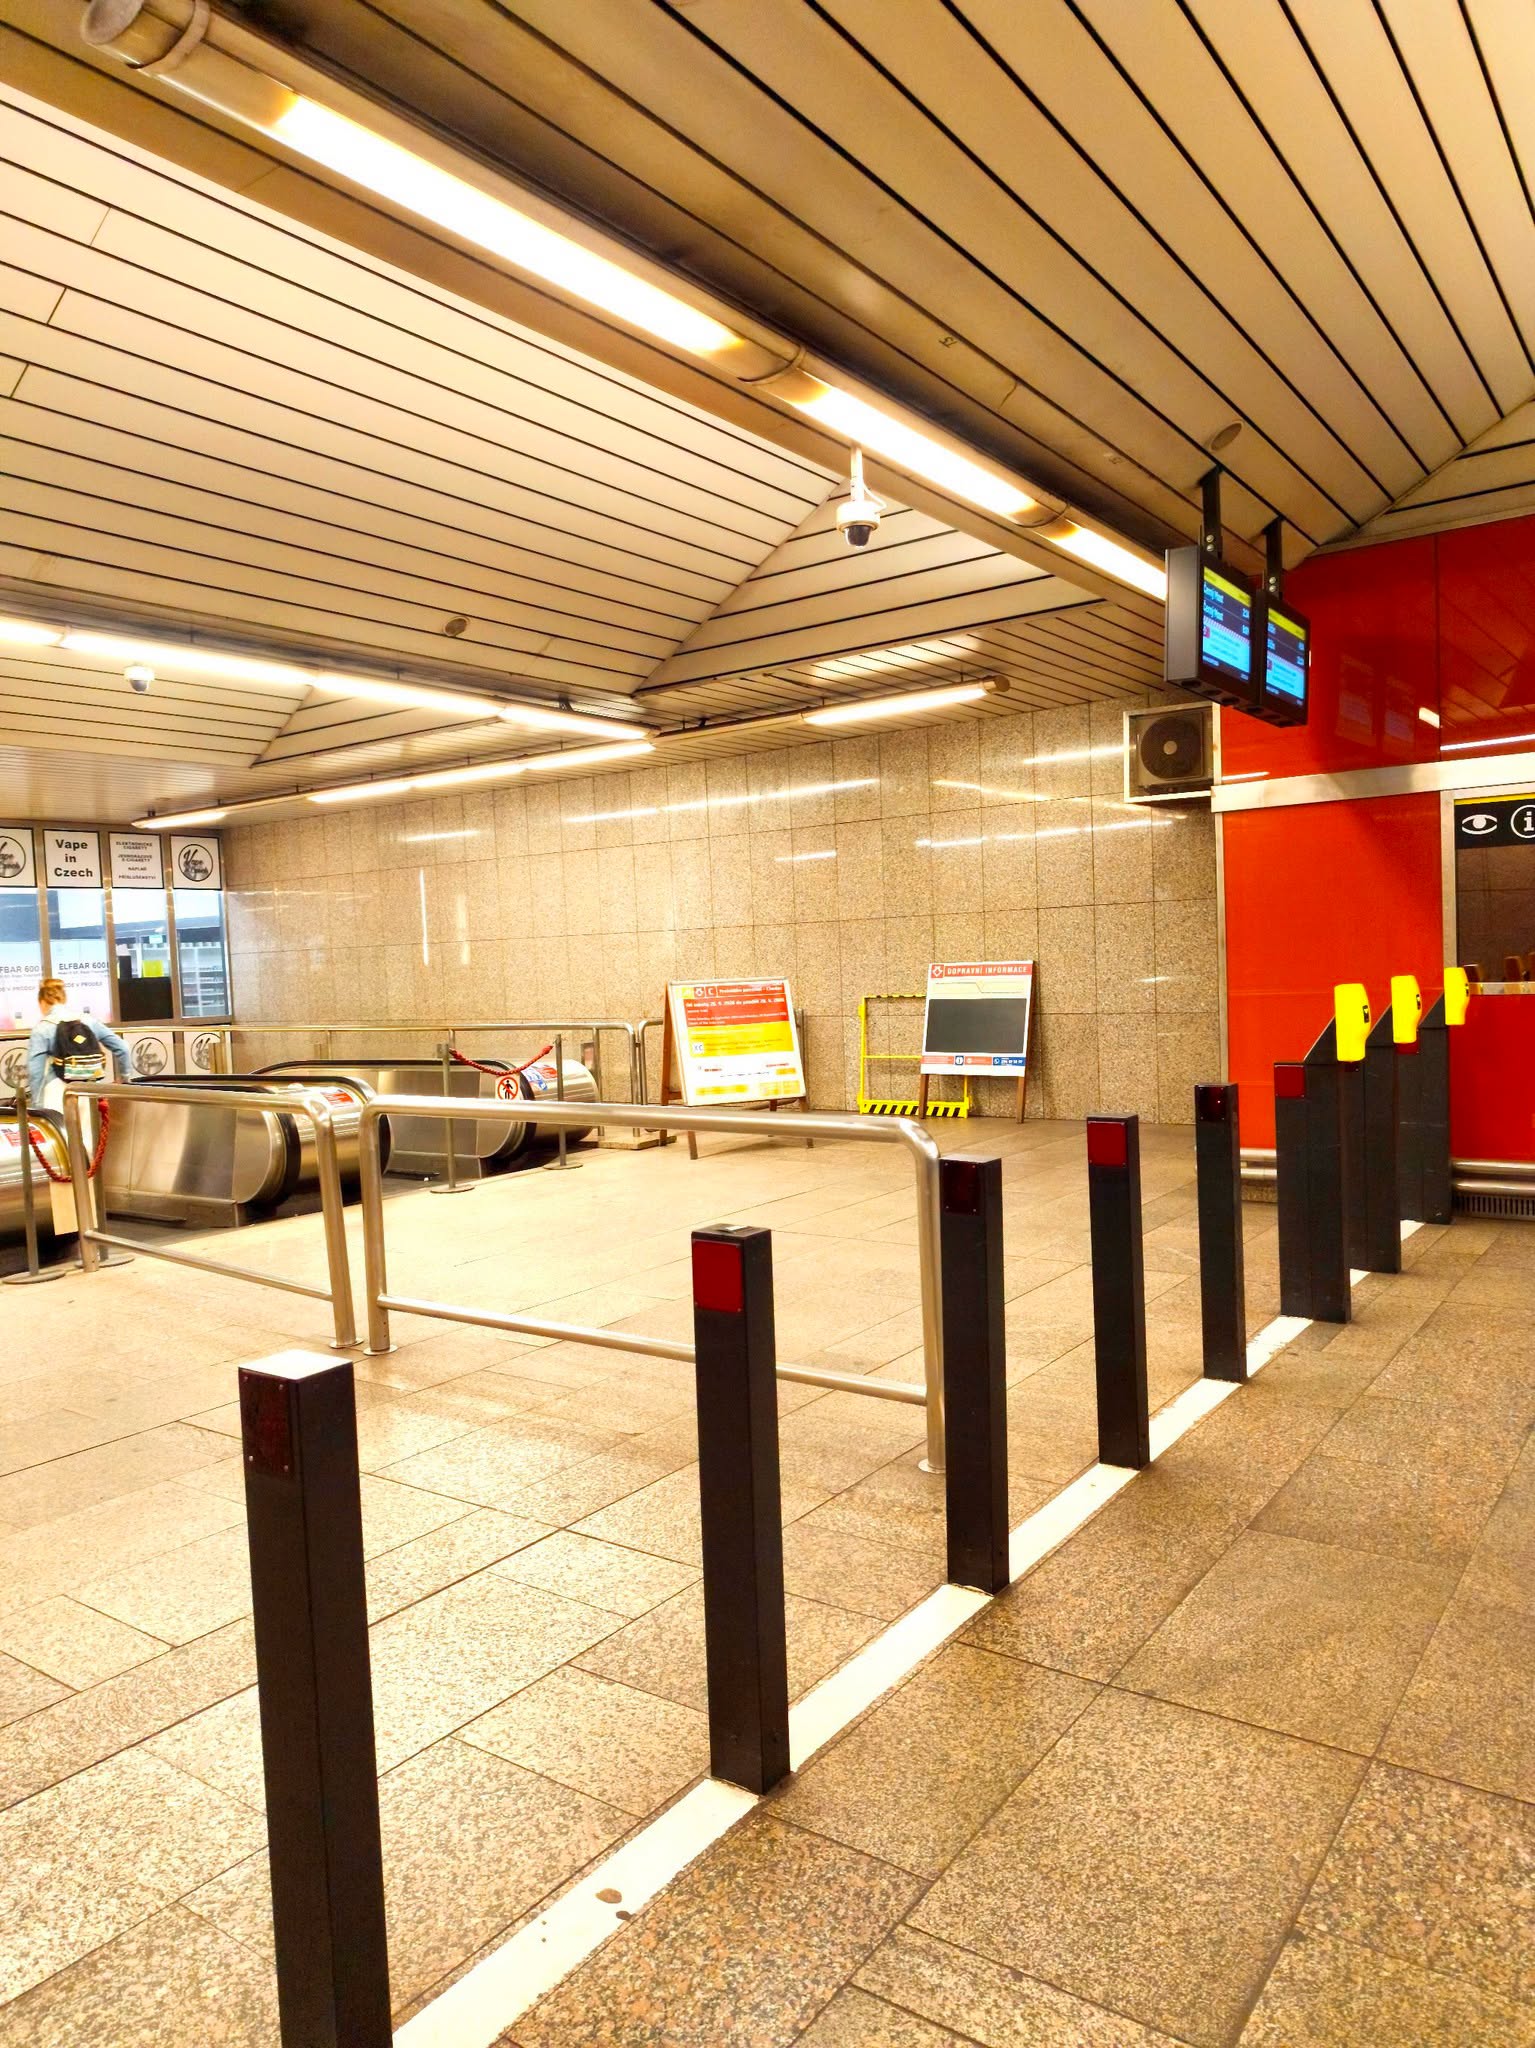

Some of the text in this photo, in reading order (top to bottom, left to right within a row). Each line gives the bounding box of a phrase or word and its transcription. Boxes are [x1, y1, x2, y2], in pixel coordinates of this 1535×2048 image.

[55, 839, 88, 851] Vape
[65, 853, 77, 863] in
[54, 867, 93, 877] Czech
[58, 962, 90, 971] ELFBAR
[947, 966, 1027, 975] DOPRAVNÍ INFORMACE
